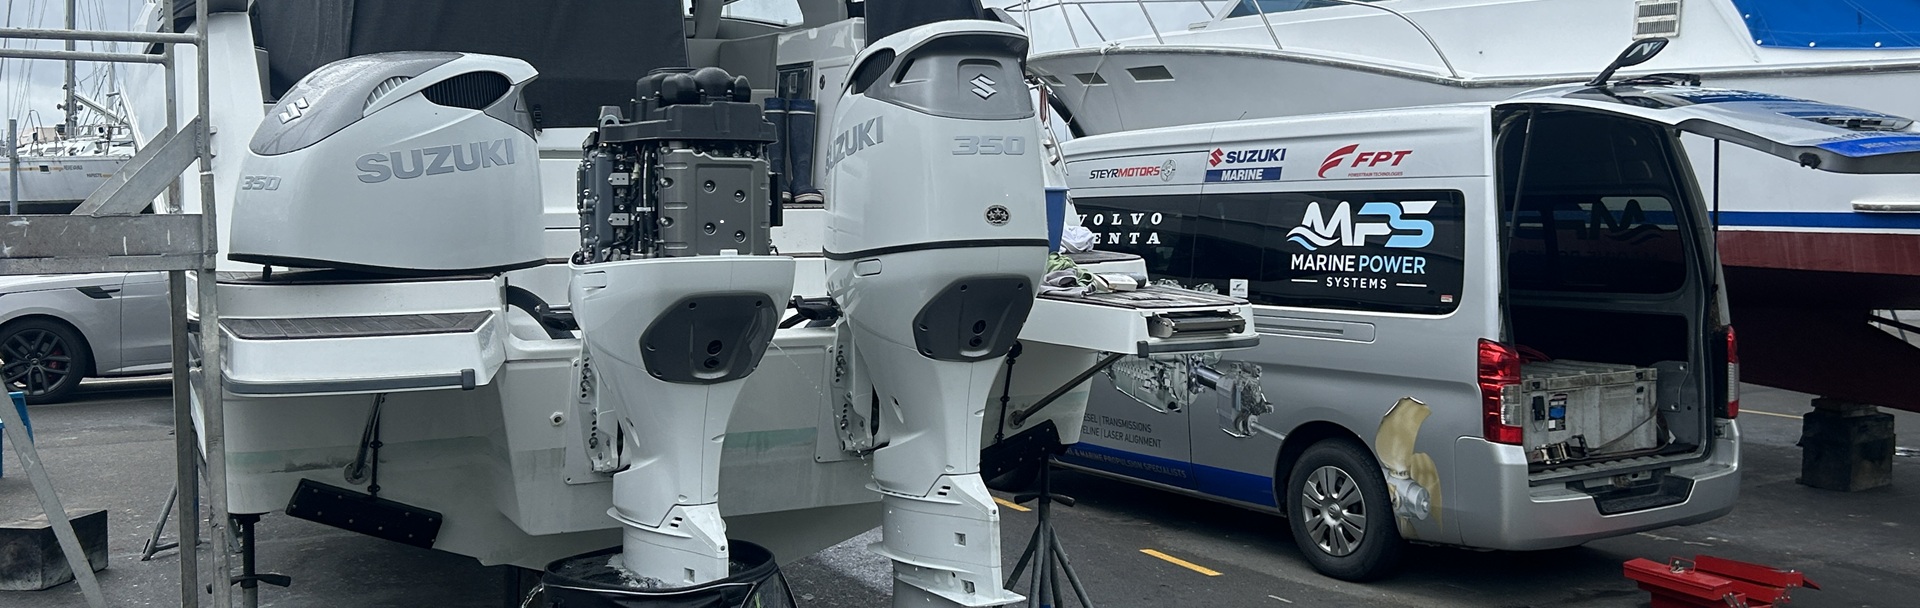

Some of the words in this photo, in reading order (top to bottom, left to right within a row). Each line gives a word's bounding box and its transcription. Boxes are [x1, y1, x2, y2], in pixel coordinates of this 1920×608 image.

[825, 115, 883, 176] SUZUKI
[952, 135, 1026, 155] 350
[356, 138, 515, 184] SUZUKI
[1225, 148, 1287, 164] SUZUKI
[1350, 150, 1413, 168] FPT
[242, 175, 282, 191] 350
[1221, 168, 1264, 181] MARINE
[1287, 200, 1438, 249] MPS
[1093, 232, 1161, 245] ENTA
[1291, 253, 1356, 272] MARINE
[1358, 255, 1426, 274] POWER
[1326, 276, 1387, 289] SYSTEMS
[1084, 412, 1098, 424] ESEL
[1102, 415, 1152, 433] TRANSMISSIONS
[1081, 425, 1100, 437] ELINE
[1103, 429, 1124, 441] LASER
[1124, 433, 1162, 449] ALIGNMENT
[1079, 450, 1104, 462] MARINE
[1103, 454, 1143, 470] PROPULSION
[1143, 462, 1187, 479] SPECIALISTS
